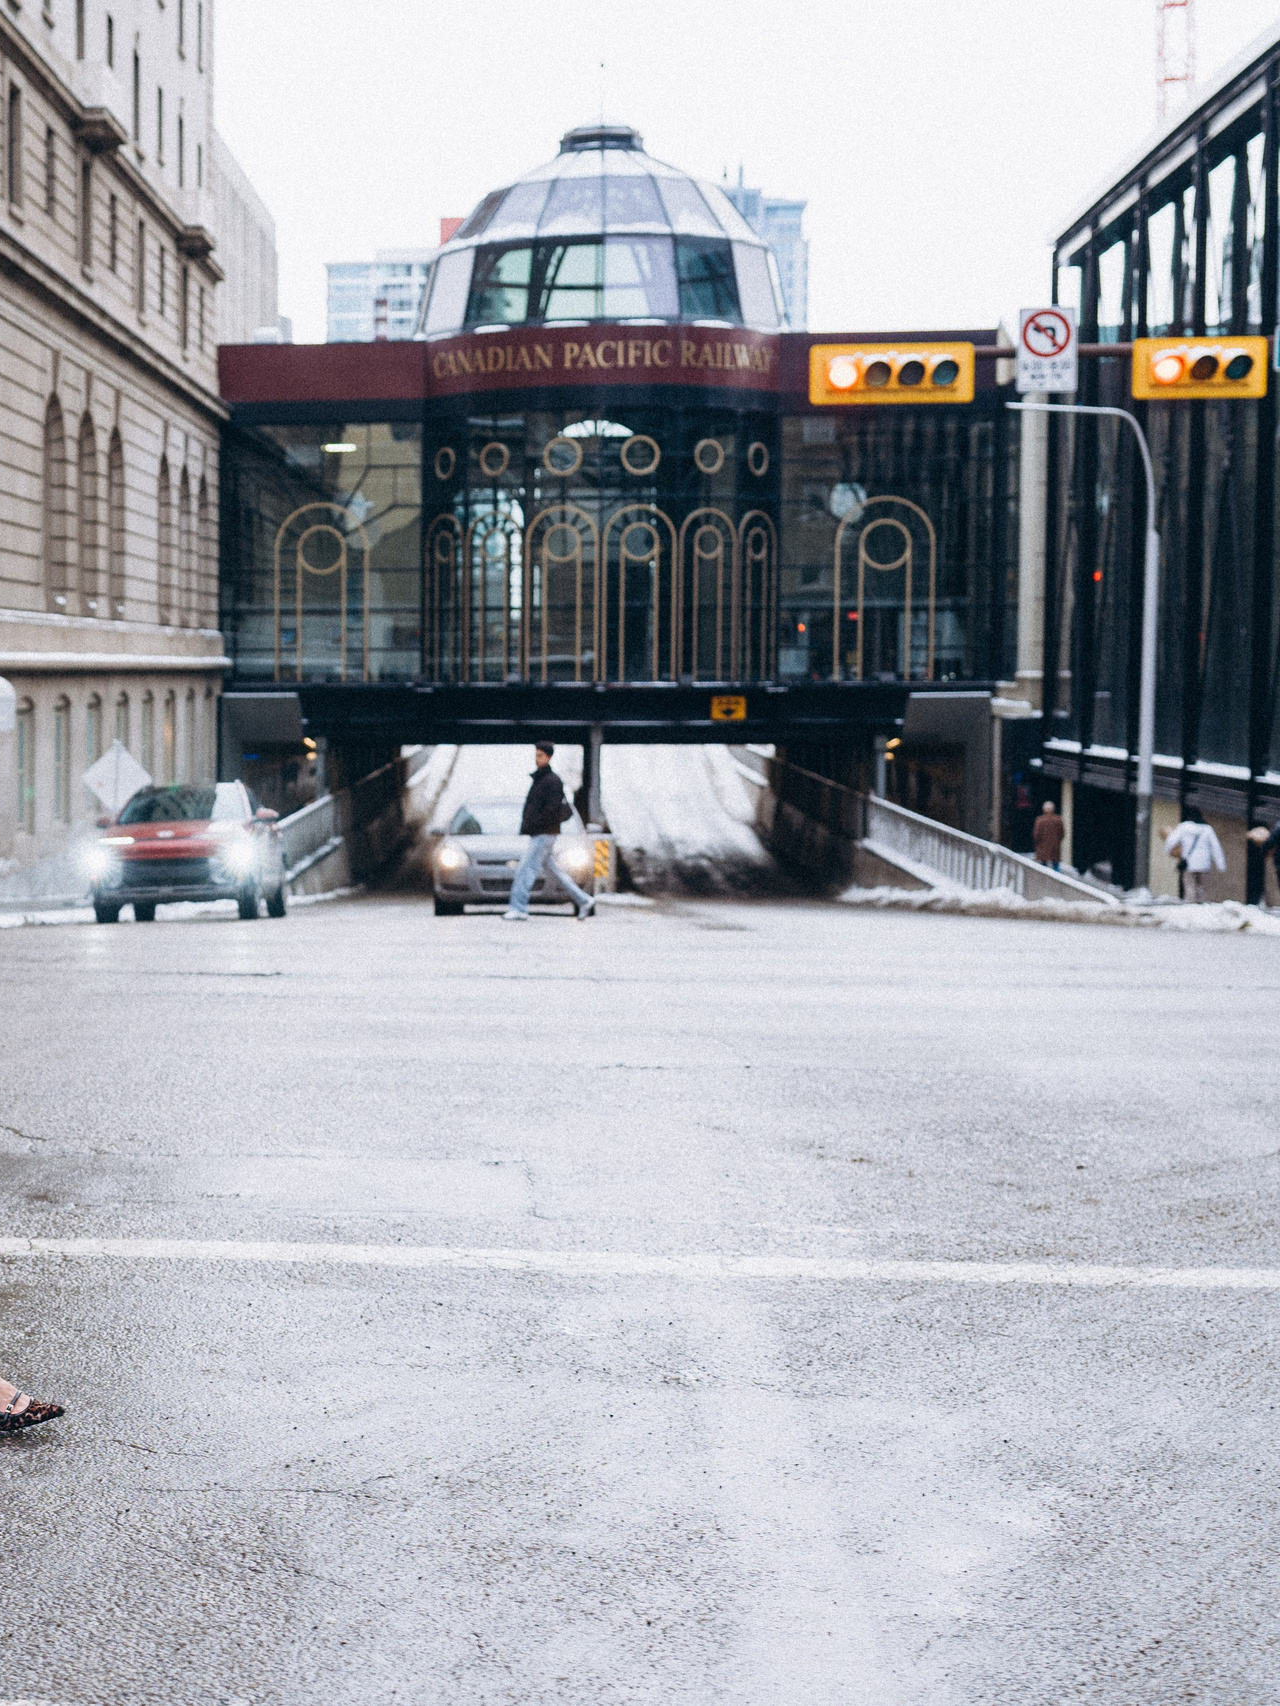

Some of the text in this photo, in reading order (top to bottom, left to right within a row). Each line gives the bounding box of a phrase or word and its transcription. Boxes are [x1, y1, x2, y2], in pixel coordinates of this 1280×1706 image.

[433, 340, 774, 379] CANADIAN PACIFIC RAILWAY
